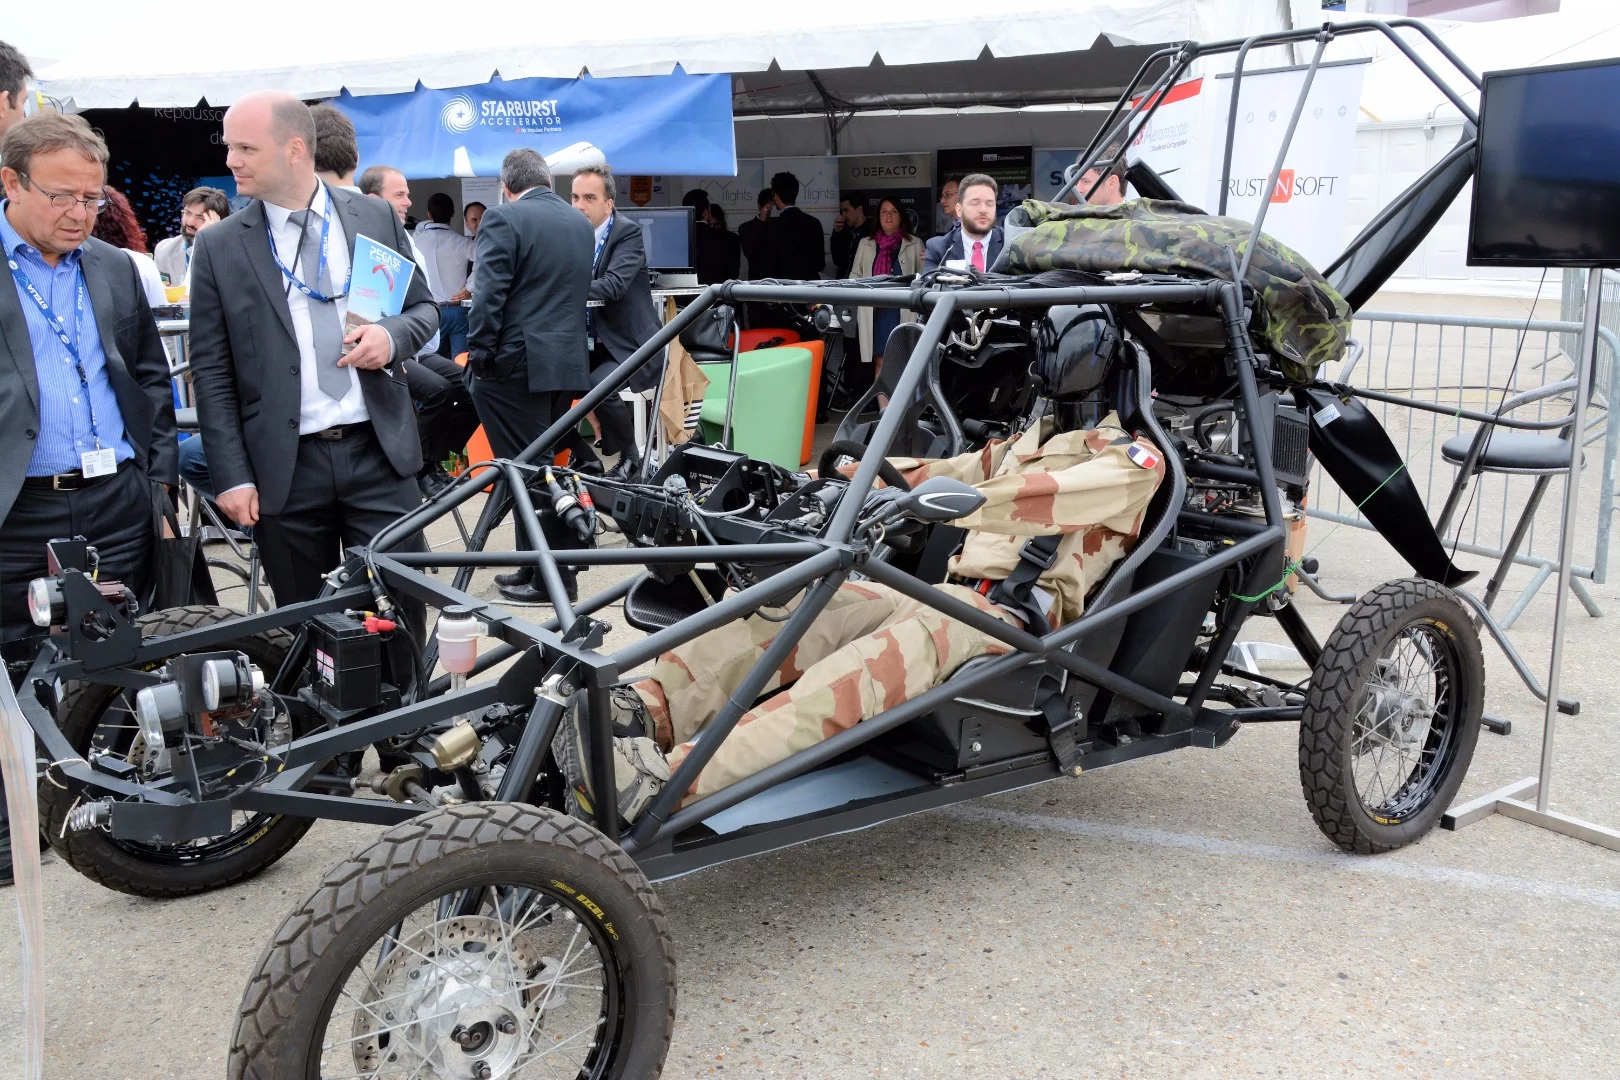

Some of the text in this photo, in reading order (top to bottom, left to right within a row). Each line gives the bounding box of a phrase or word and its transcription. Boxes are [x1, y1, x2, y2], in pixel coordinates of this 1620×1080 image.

[154, 107, 225, 122] Repousso
[481, 100, 558, 117] STARBURST
[480, 117, 562, 126] ACCELERATOR
[863, 166, 917, 177] DEFACTO
[1293, 176, 1338, 196] SOFT
[369, 245, 402, 268] PEGASE
[27, 283, 49, 310] STELIA
[576, 894, 605, 920] EXCEL
